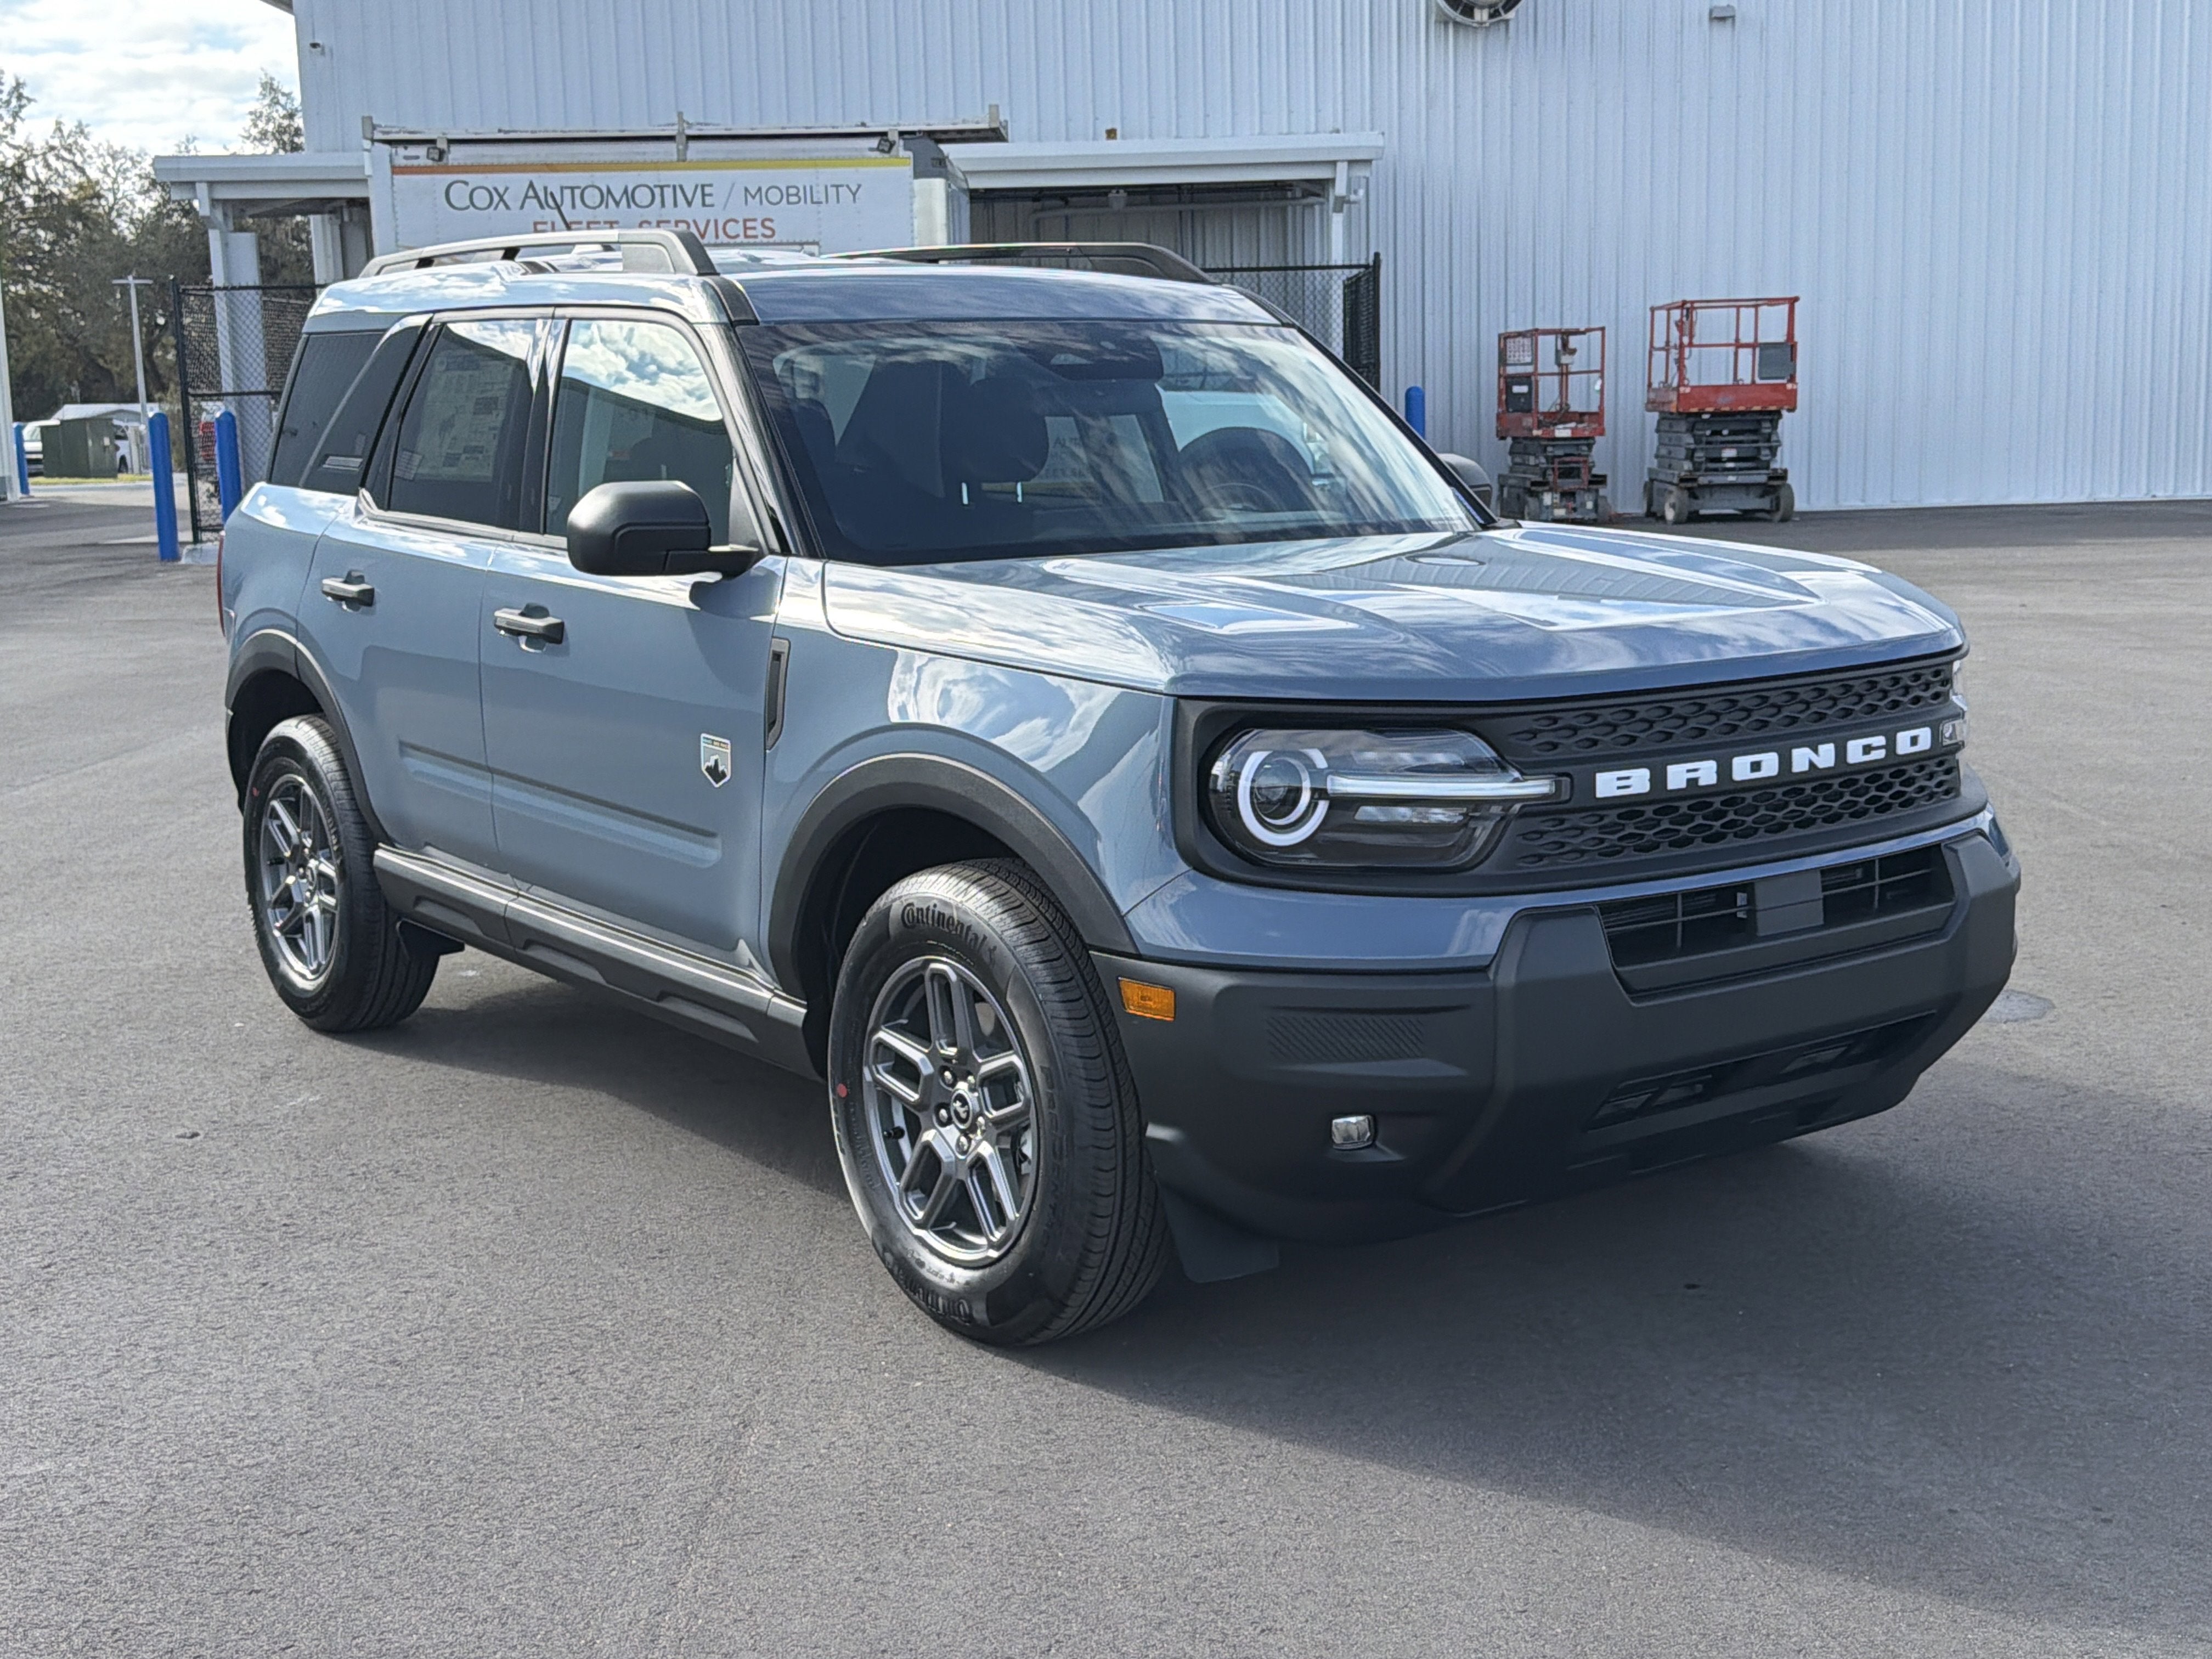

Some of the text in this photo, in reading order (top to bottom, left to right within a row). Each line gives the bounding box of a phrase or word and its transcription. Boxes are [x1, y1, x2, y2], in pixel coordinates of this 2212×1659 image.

[743, 184, 862, 206] MOBILITY
[1595, 726, 1932, 799] BRONCO
[900, 902, 988, 953] Continental
